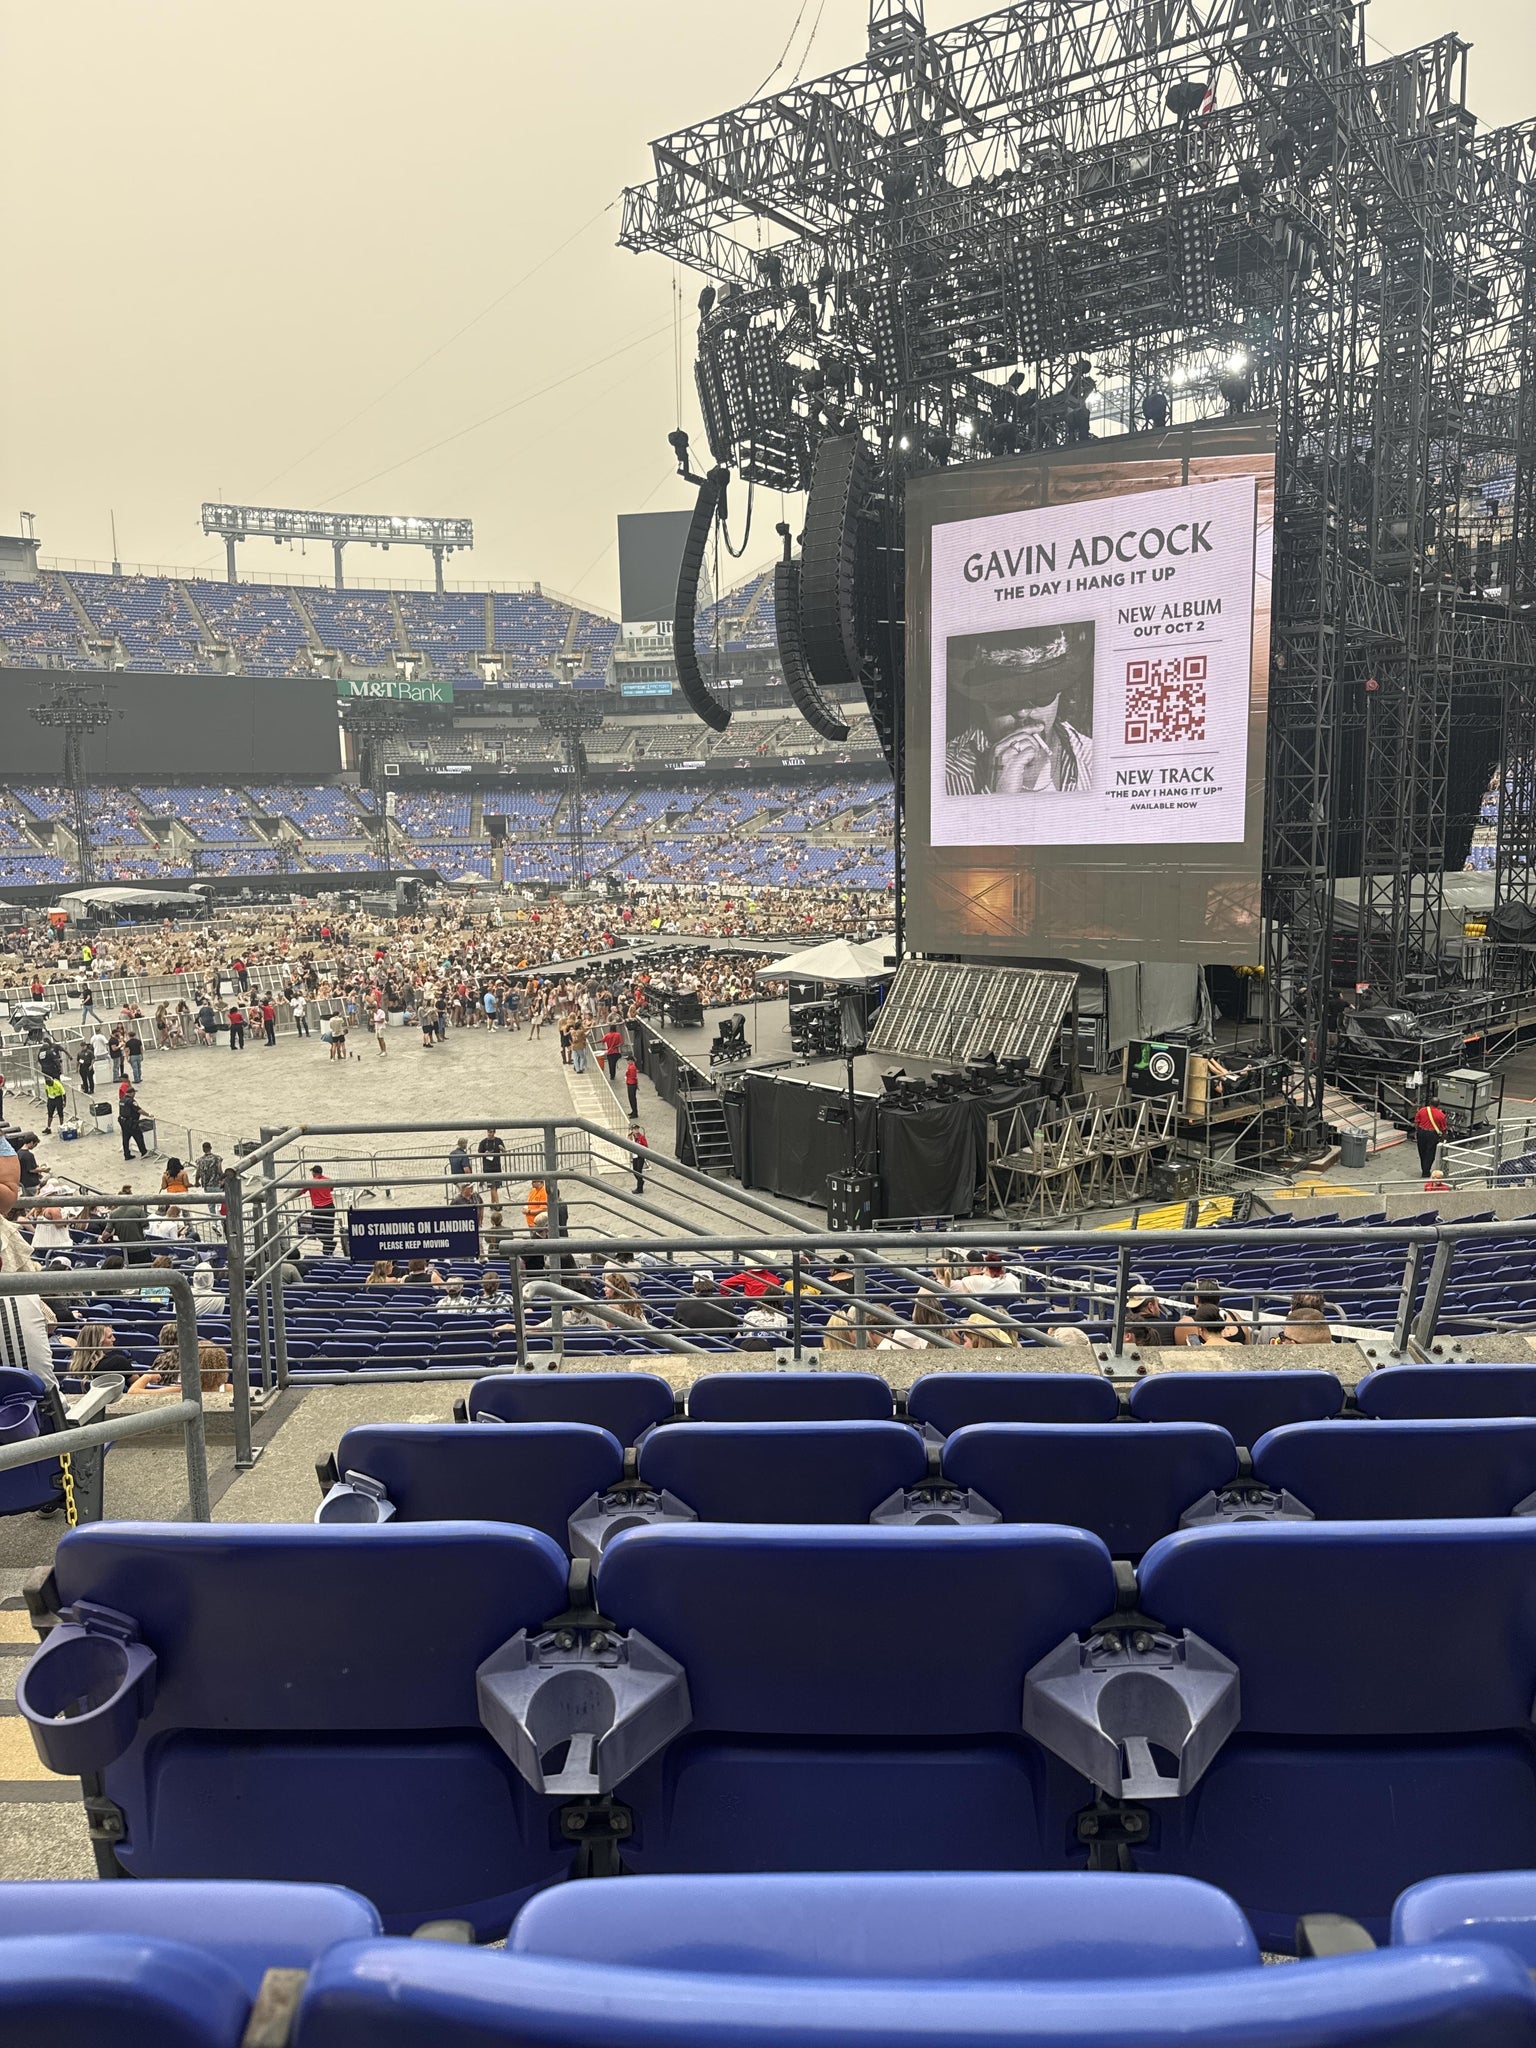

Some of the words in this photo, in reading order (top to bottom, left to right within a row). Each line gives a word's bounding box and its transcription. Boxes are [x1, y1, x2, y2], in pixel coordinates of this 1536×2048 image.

[963, 541, 1056, 583] GAVIN
[1067, 520, 1214, 570] ADCOCK
[993, 585, 1025, 602] THE
[1029, 580, 1062, 597] DAY
[1066, 579, 1071, 593] I
[1076, 572, 1125, 592] HANG
[1130, 570, 1147, 585] IT
[1151, 566, 1176, 582] UP
[1117, 604, 1157, 625] NEW
[1160, 598, 1222, 620] ALBUM
[1133, 625, 1162, 638] OUT
[1164, 621, 1194, 635] OCT
[1196, 620, 1206, 632] 2
[349, 681, 398, 699] M&T
[397, 682, 444, 701] Bank
[1116, 769, 1154, 785] NEW
[1159, 766, 1215, 784] TRACK
[1131, 789, 1151, 798] DAY
[1159, 788, 1188, 797] HANG
[1190, 787, 1201, 796] IT
[1130, 802, 1175, 810] AVAILABLE
[351, 1223, 365, 1237] NO
[367, 1221, 415, 1237] STANDING
[417, 1220, 431, 1234] ON
[433, 1219, 476, 1233] LANDING
[379, 1240, 404, 1251] PLEASE
[404, 1239, 422, 1250] KEEP
[422, 1238, 450, 1249] MOVING
